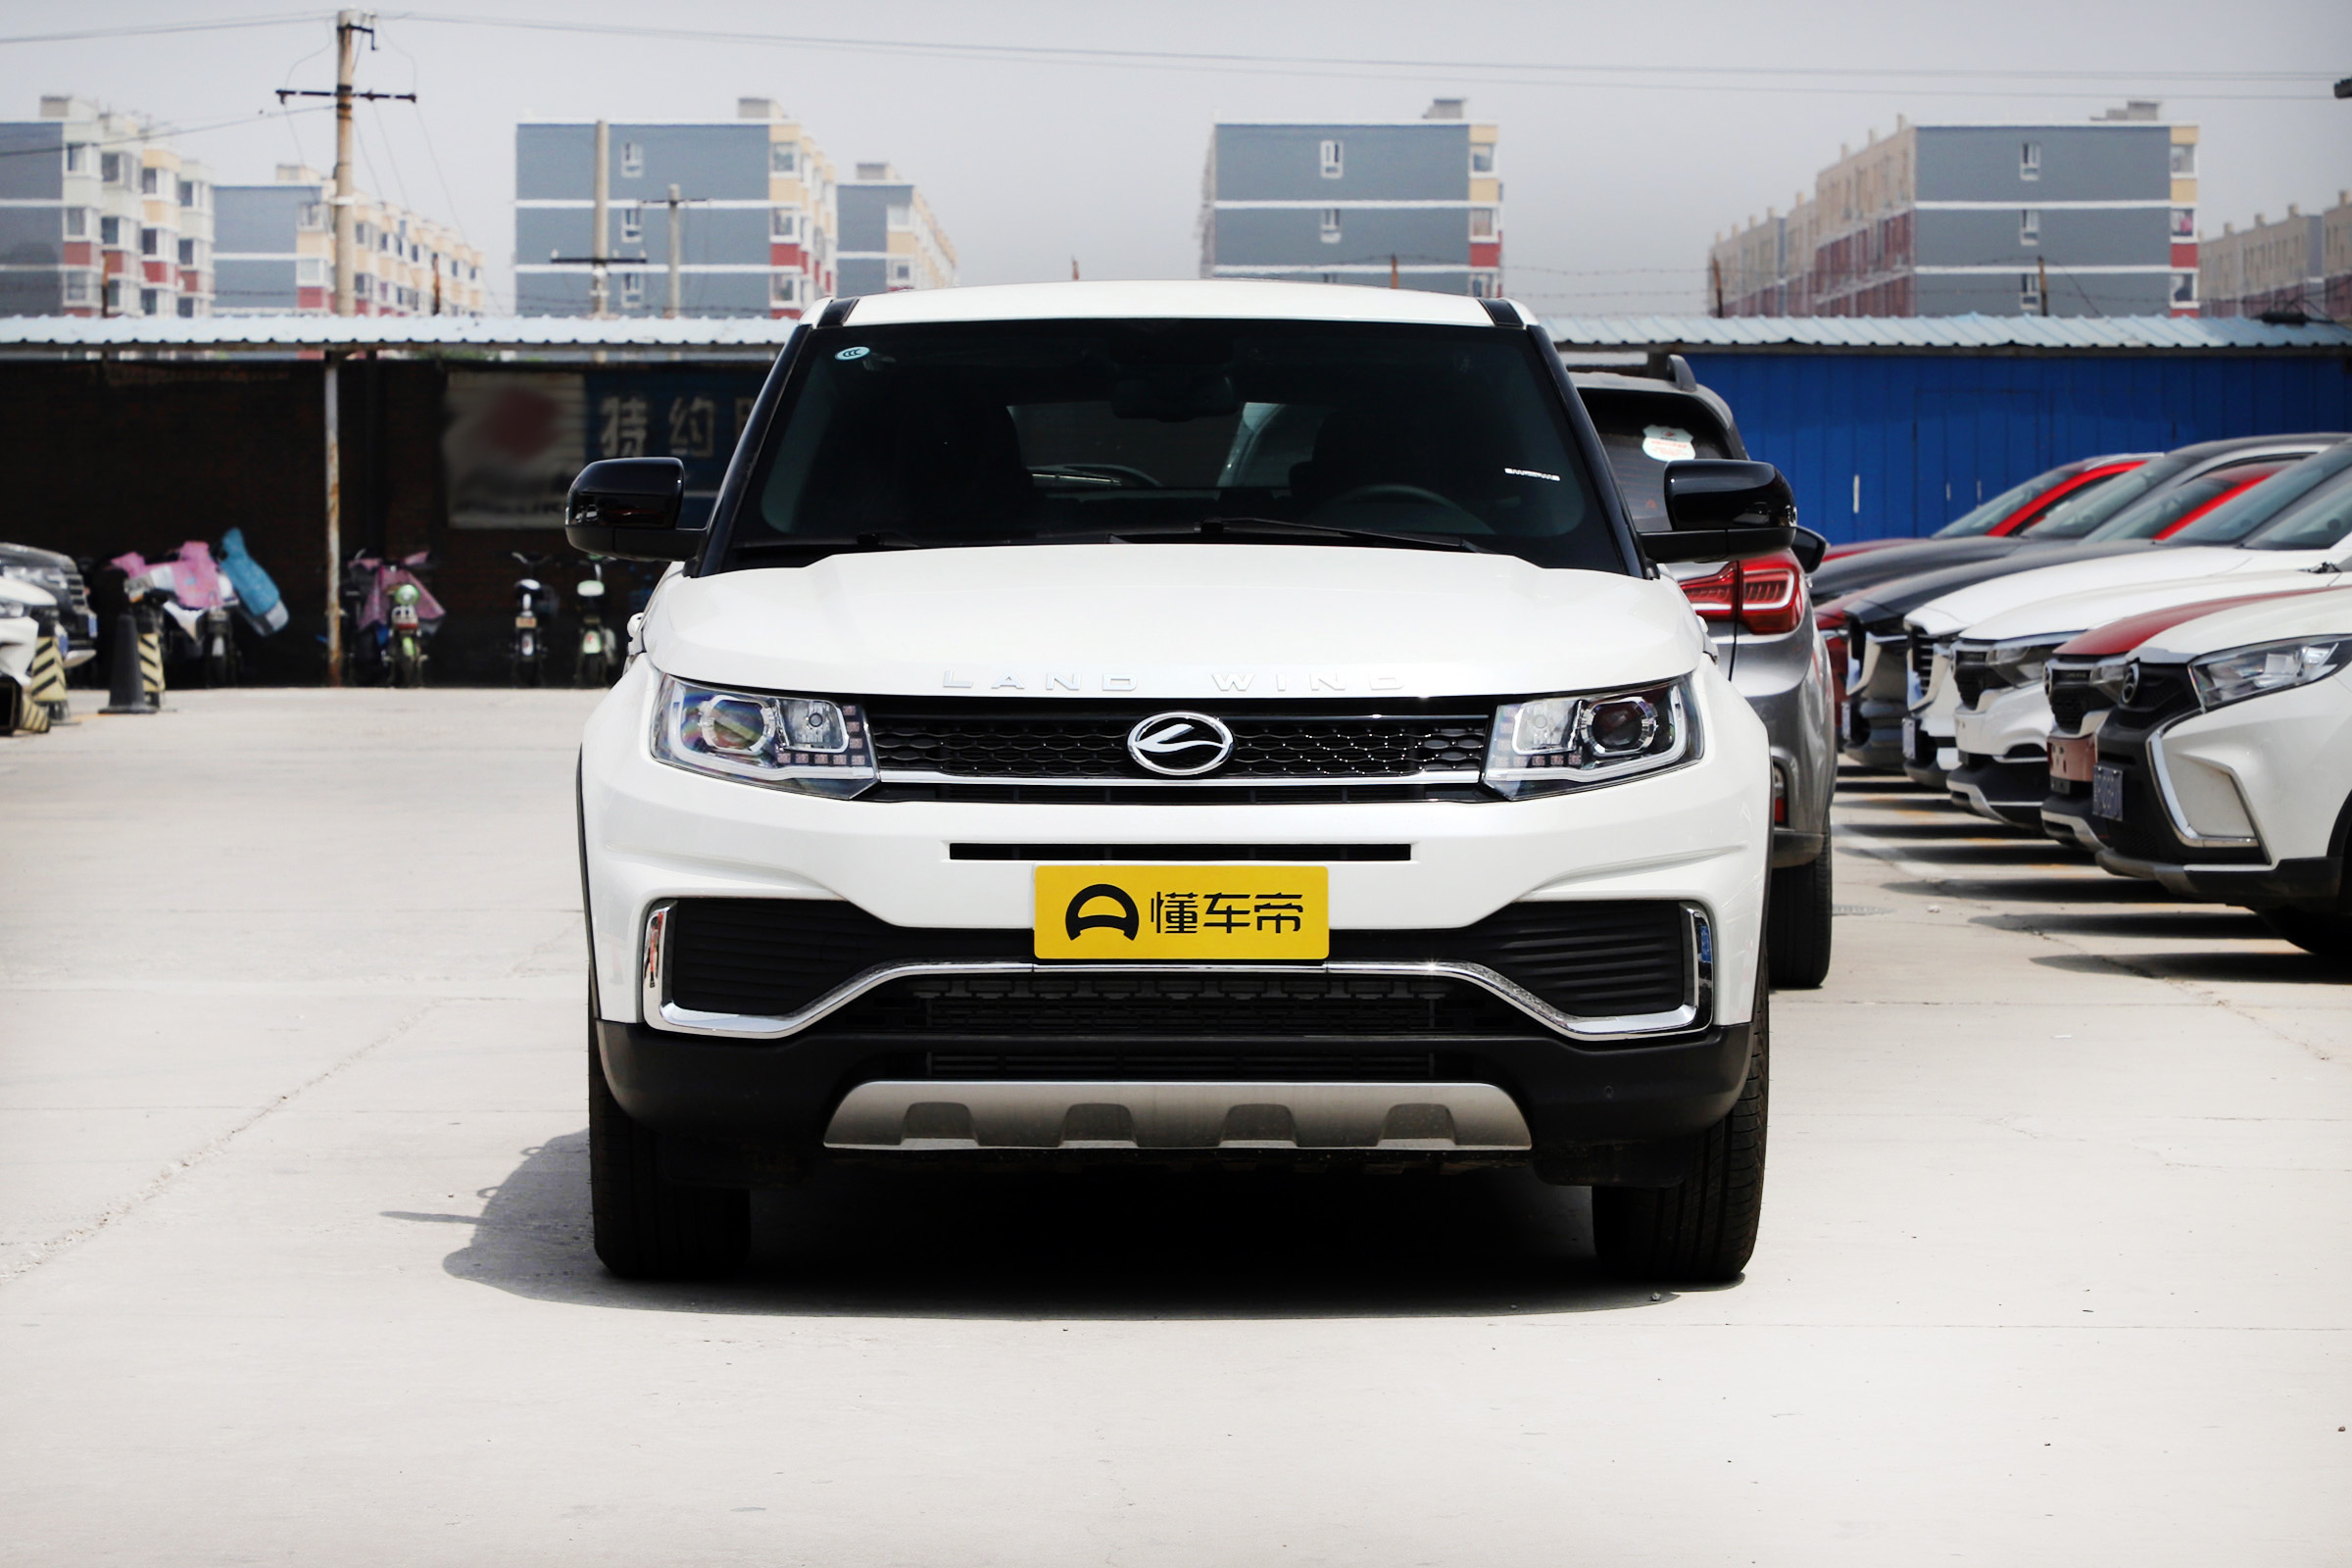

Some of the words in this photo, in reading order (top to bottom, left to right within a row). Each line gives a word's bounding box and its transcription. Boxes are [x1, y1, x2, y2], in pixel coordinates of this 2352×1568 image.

[600, 395, 755, 458] 特约
[943, 670, 1138, 692] LAND
[1211, 672, 1405, 692] WIND
[1151, 891, 1304, 934] 懂车帝
